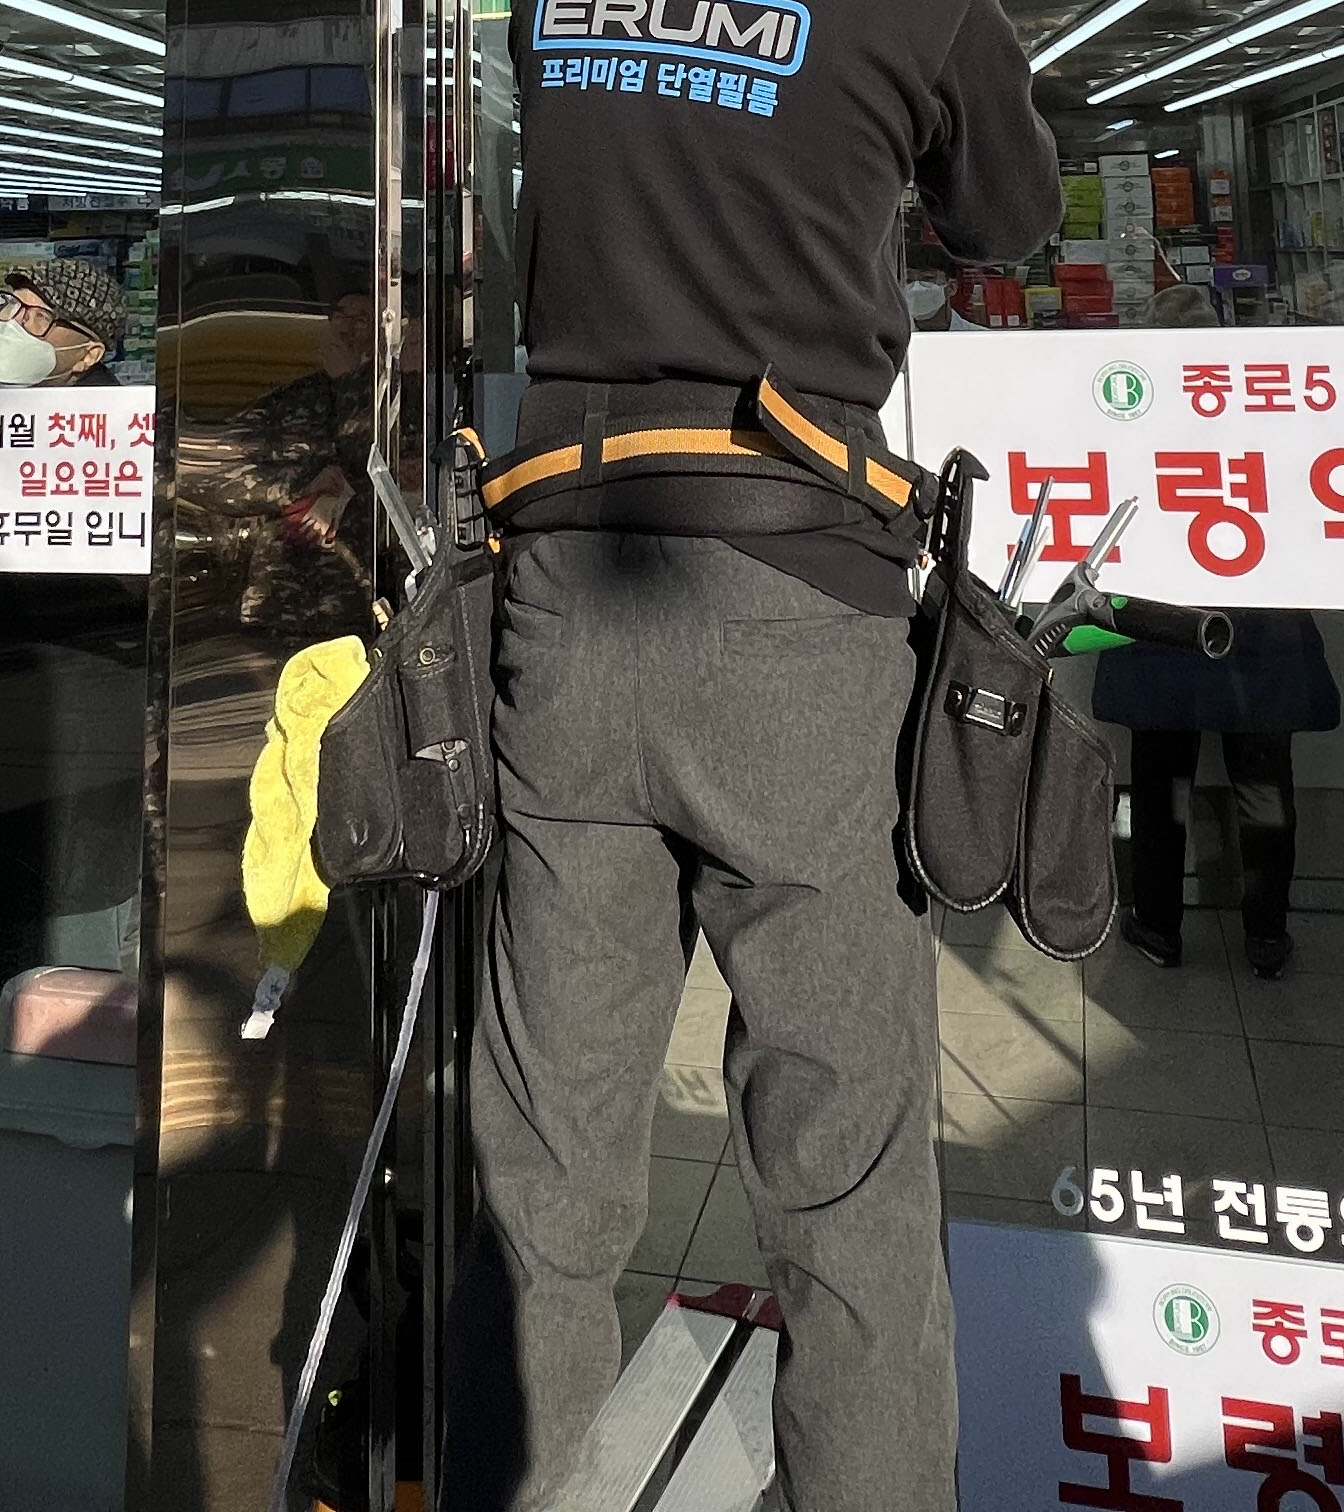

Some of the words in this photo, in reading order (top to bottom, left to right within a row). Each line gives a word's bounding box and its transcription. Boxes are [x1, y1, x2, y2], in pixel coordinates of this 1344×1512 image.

[540, 56, 649, 95] 프리미엄
[656, 61, 780, 119] 단열필름
[47, 412, 116, 451] 첫째,
[19, 460, 144, 498] 일요일은
[85, 509, 146, 548] 입니
[1050, 1164, 1187, 1236] 65년
